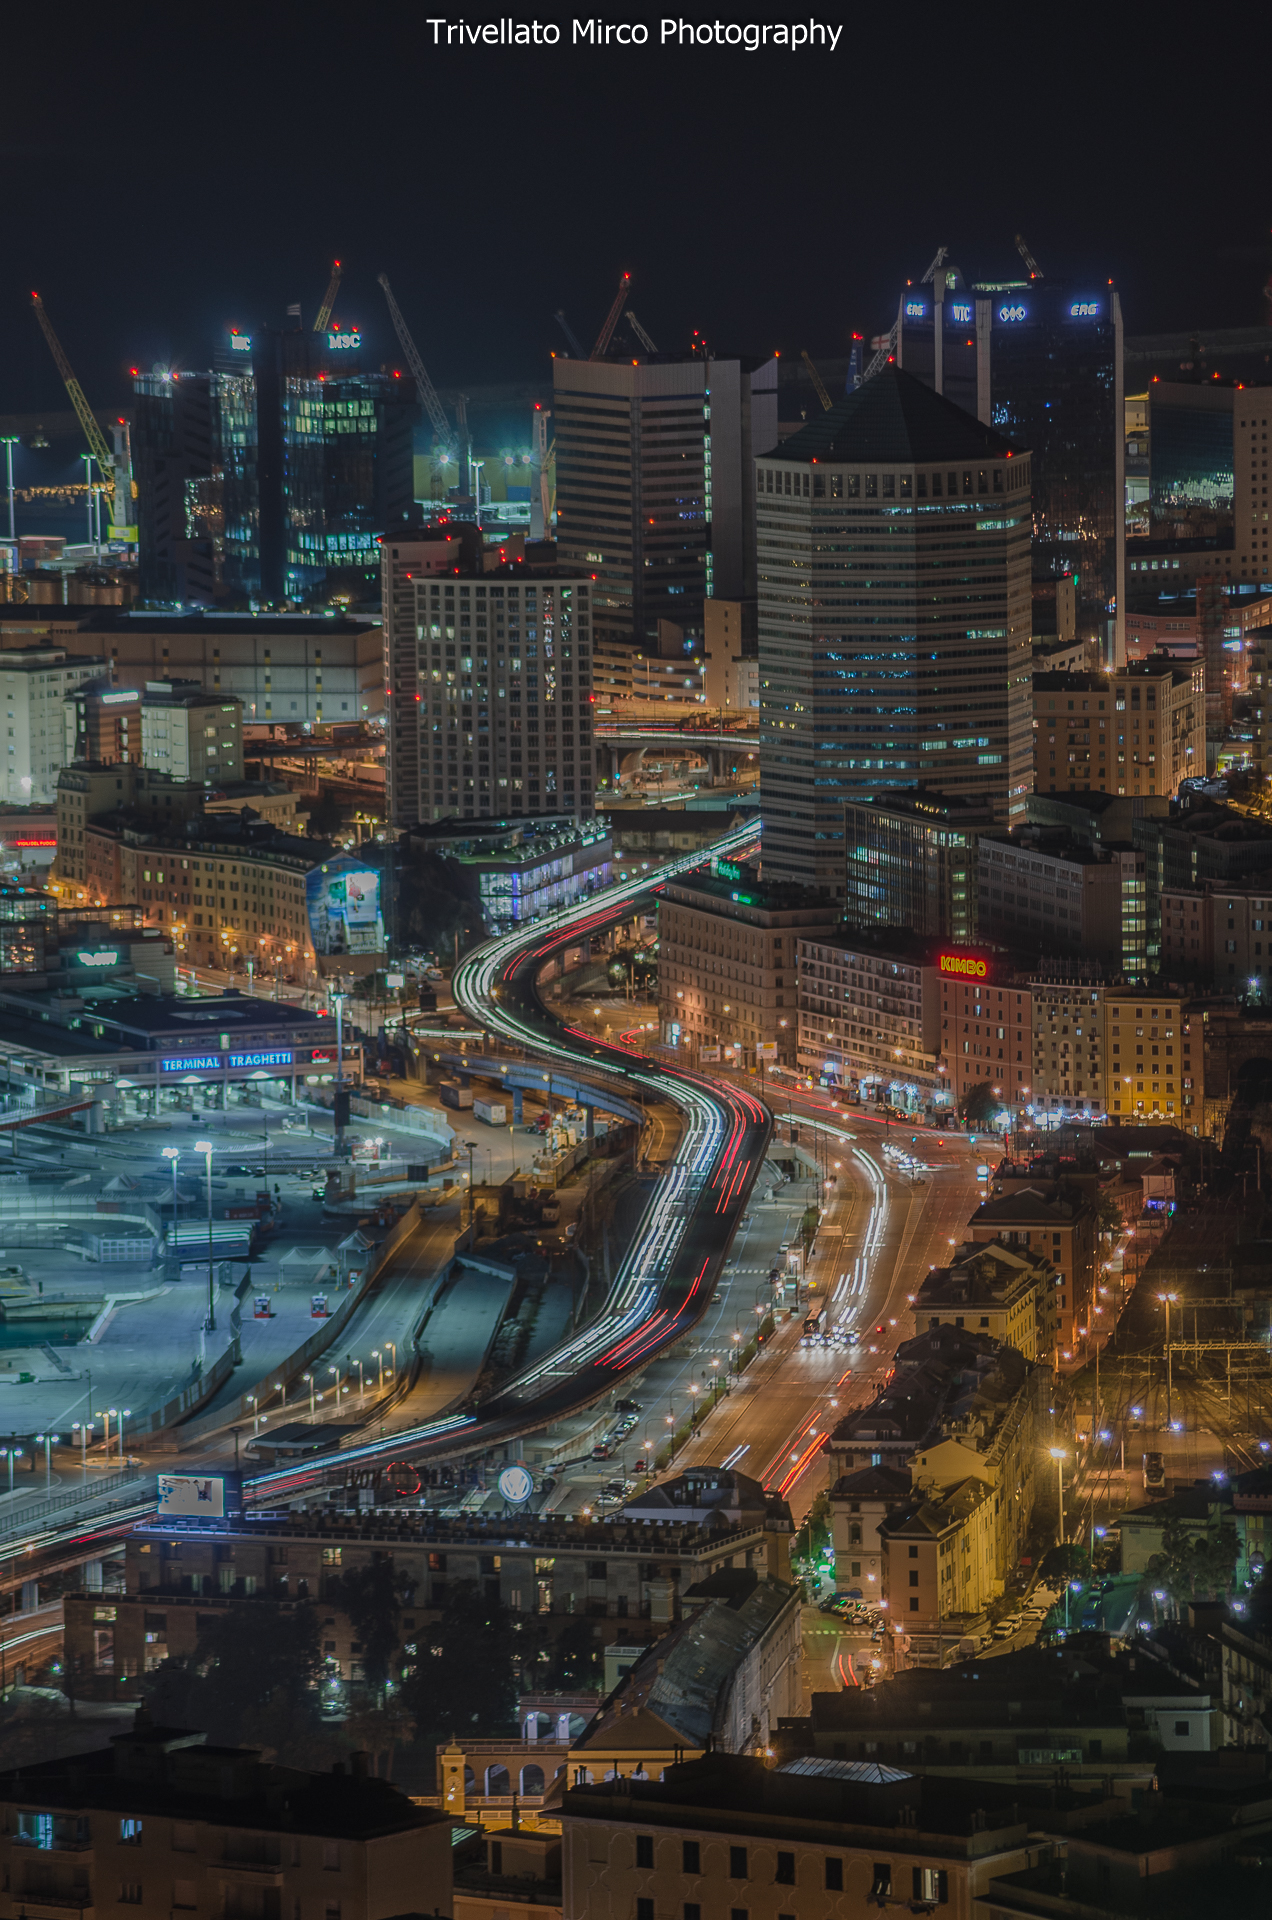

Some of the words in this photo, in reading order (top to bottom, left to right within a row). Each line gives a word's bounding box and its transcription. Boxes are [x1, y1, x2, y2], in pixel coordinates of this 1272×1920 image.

[1070, 304, 1098, 316] ERG
[328, 334, 361, 349] MSC
[940, 955, 986, 976] KIMBO
[163, 1057, 220, 1071] TERMINAL
[231, 1053, 291, 1066] TRAGHETTI
